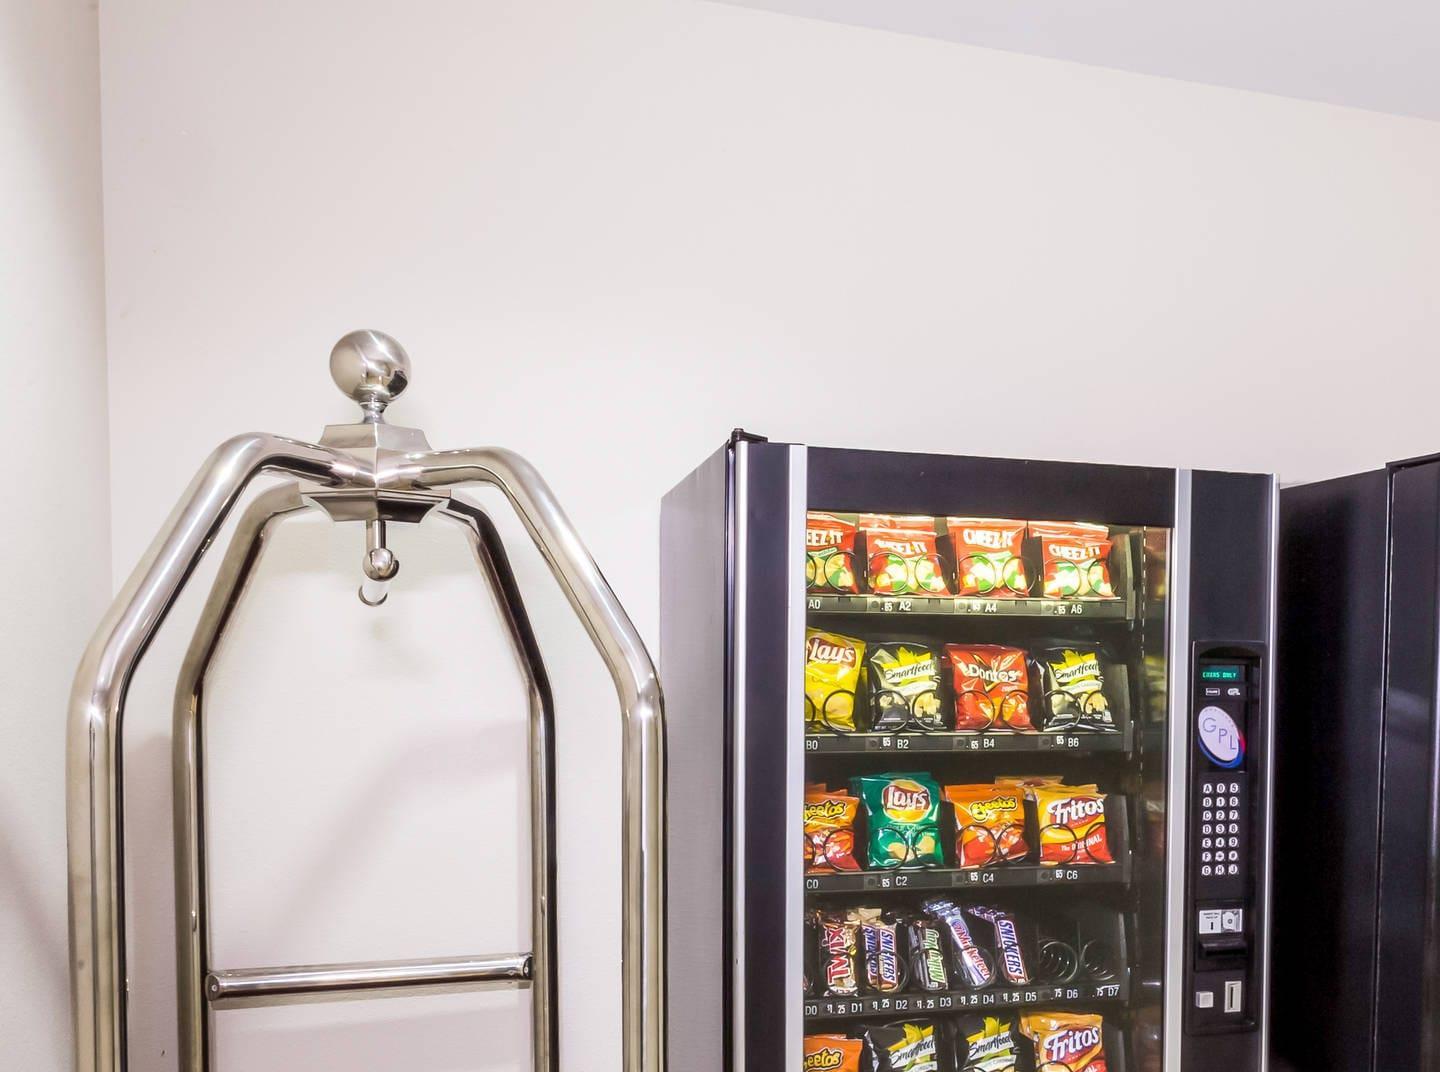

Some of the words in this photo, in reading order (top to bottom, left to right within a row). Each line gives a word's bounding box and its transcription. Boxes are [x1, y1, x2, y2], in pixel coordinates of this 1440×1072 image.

[899, 601, 912, 612] A2
[985, 602, 997, 613] A4
[1071, 604, 1083, 615] A6
[967, 663, 1018, 683] Doritos
[897, 739, 909, 749] B2
[983, 739, 995, 749] B4
[1068, 737, 1080, 748] B6
[1047, 799, 1105, 825] Fritos
[983, 873, 994, 883] C4
[1066, 870, 1078, 880] C6
[896, 876, 908, 886] C2
[827, 928, 850, 985] TWIX
[1025, 992, 1037, 1002] D5
[1067, 989, 1078, 999] D6
[1108, 987, 1119, 997] D7
[940, 998, 952, 1008] D3
[983, 994, 994, 1005] D4
[852, 1003, 863, 1013] D1
[896, 1000, 908, 1010] D2
[1044, 1026, 1099, 1061] Fritos
[804, 1049, 841, 1069] eetos
